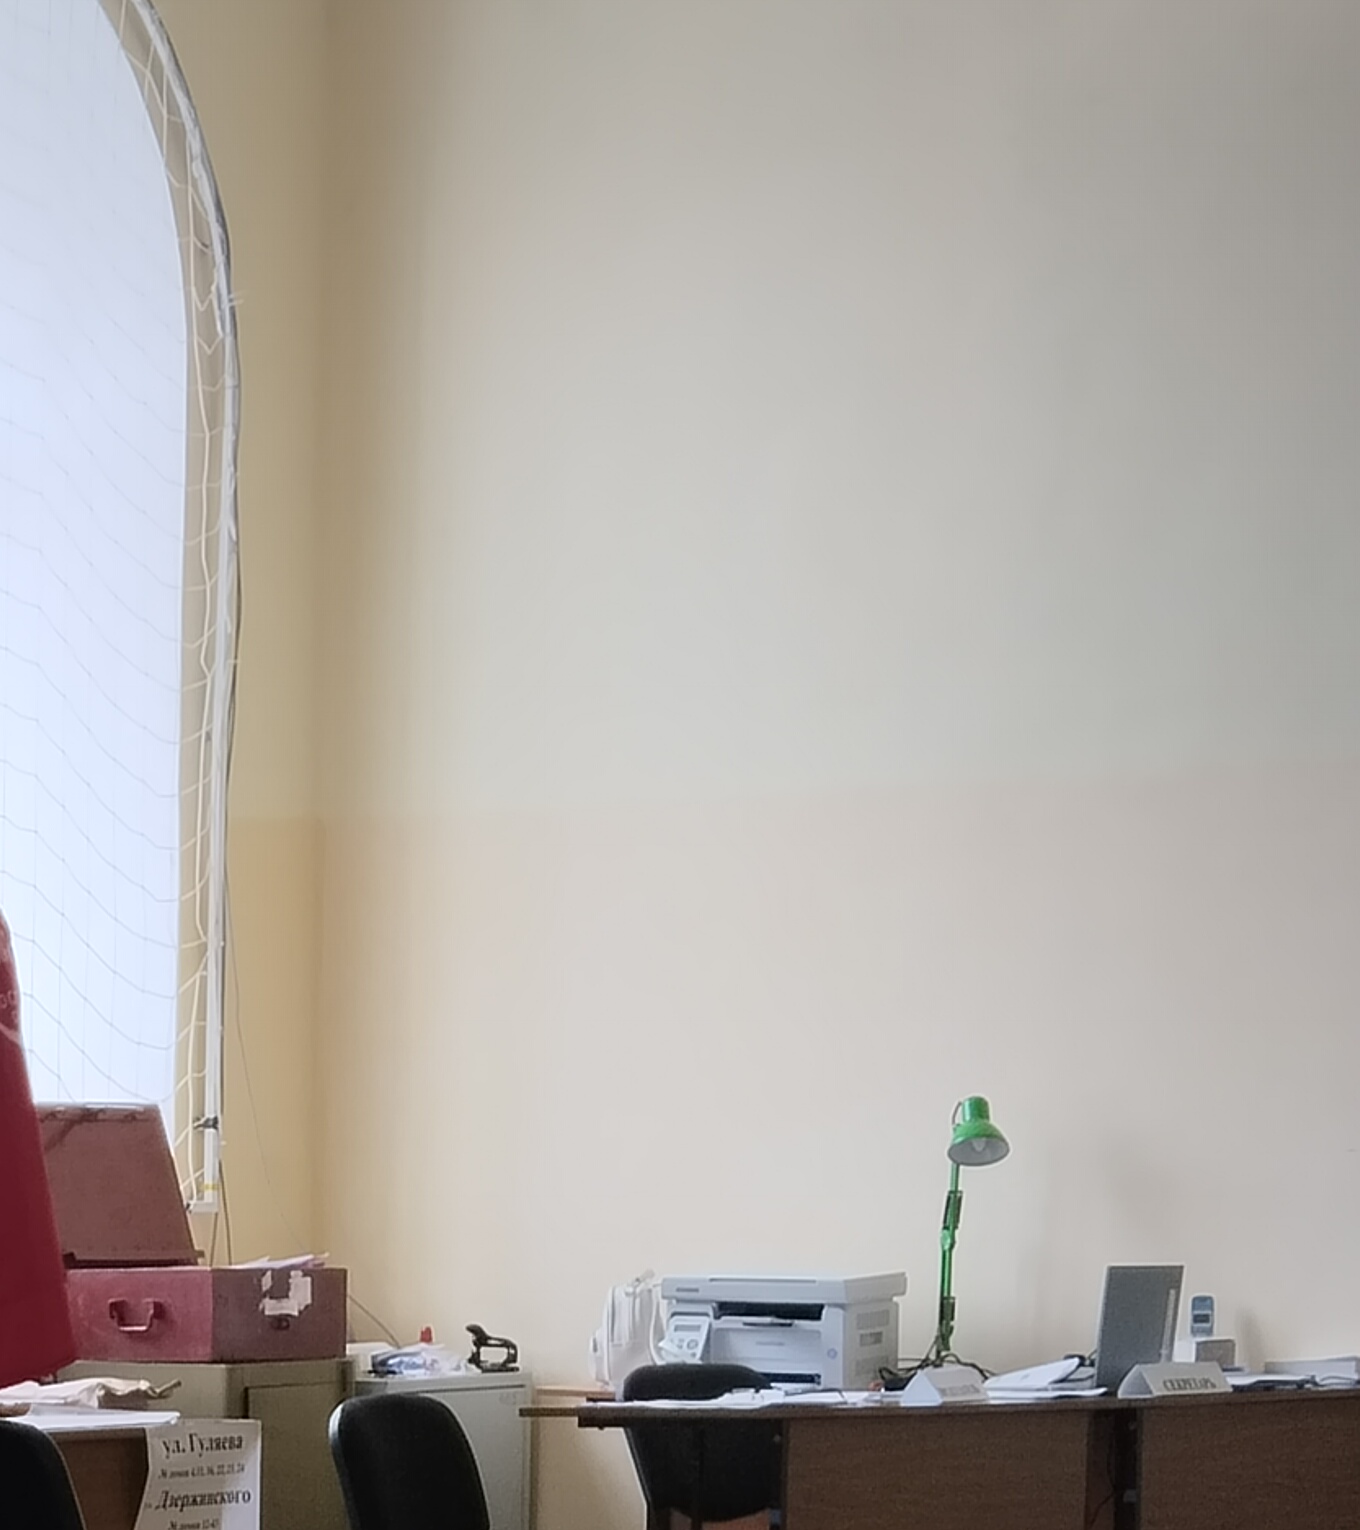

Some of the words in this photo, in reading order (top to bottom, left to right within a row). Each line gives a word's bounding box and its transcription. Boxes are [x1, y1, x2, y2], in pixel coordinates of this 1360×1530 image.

[162, 1439, 186, 1459] ул.
[188, 1432, 243, 1458] Гуляева
[155, 1489, 252, 1512] Дзержинского
